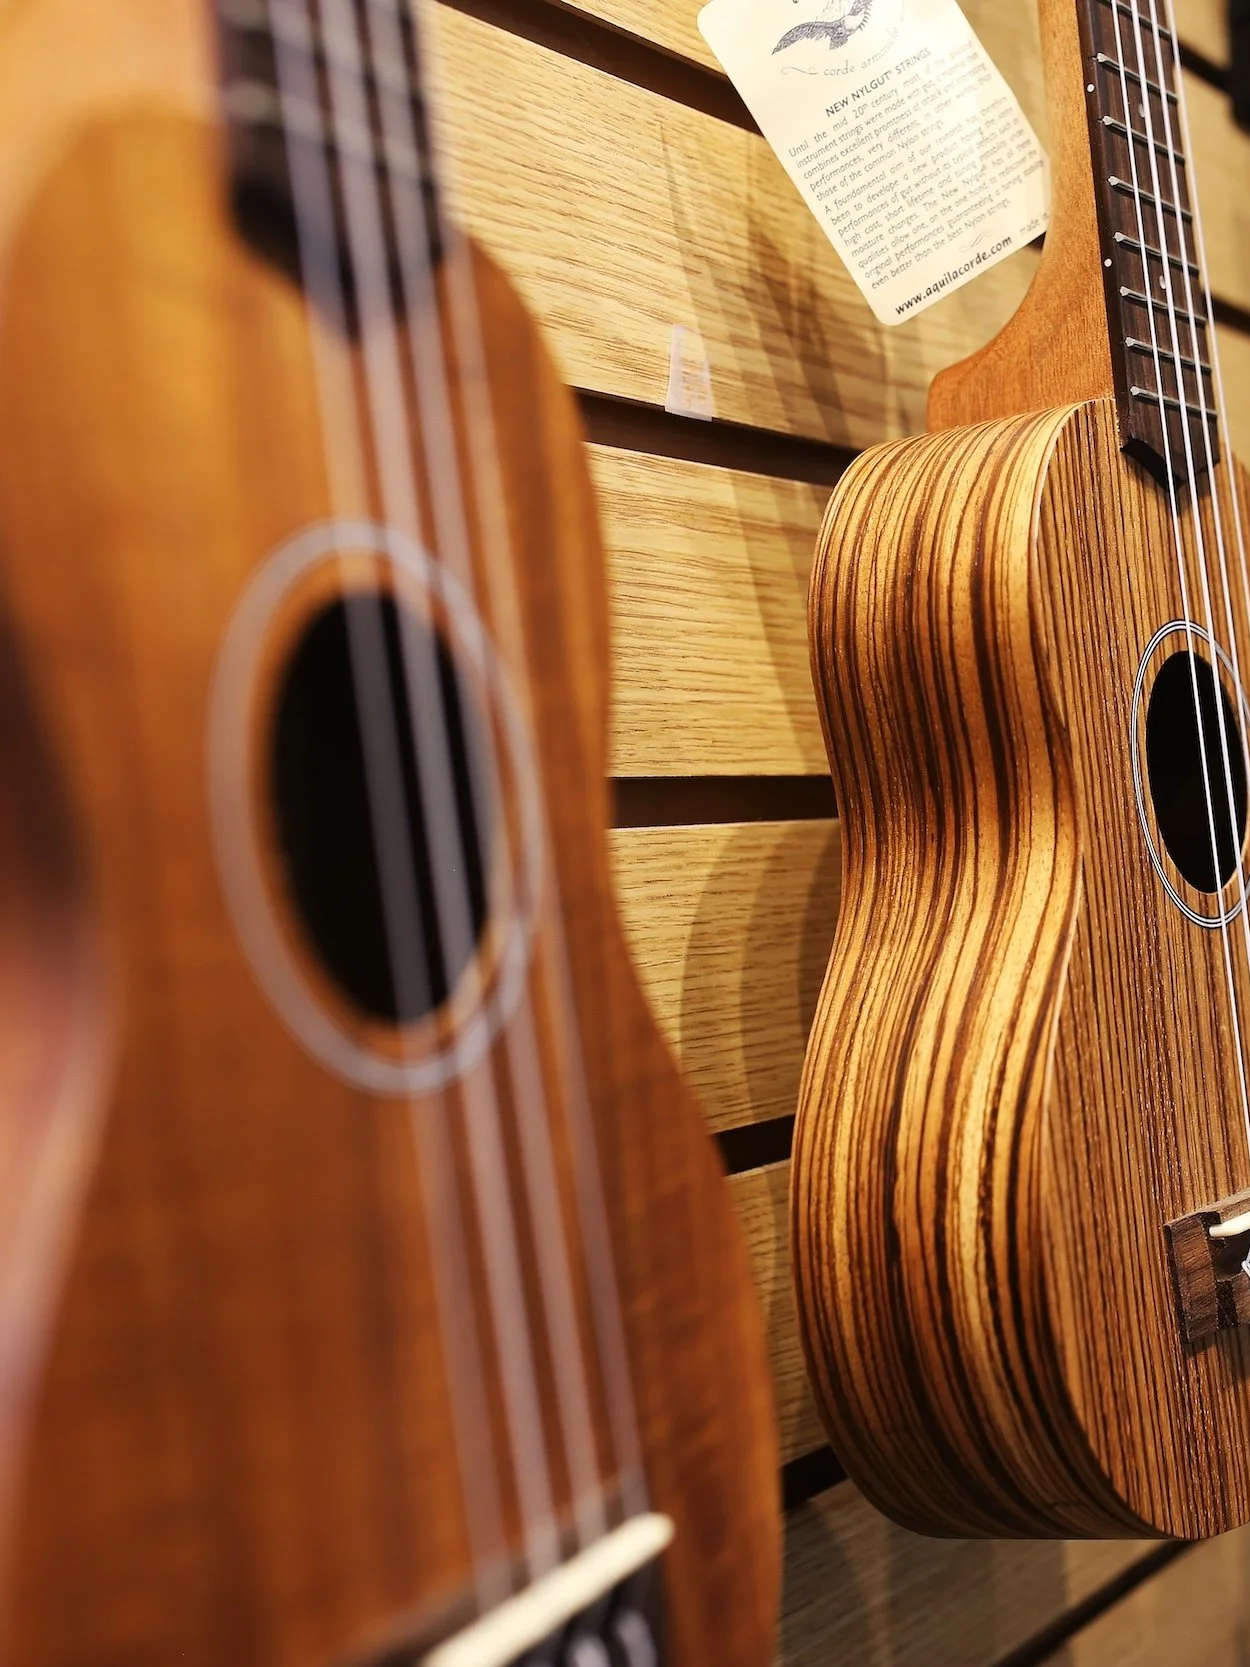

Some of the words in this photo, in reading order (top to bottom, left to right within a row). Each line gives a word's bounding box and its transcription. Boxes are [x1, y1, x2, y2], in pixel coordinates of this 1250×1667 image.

[823, 59, 855, 76] corde
[825, 97, 848, 117] NEW
[895, 47, 931, 75] STRINGS
[788, 140, 809, 157] Until
[813, 131, 827, 143] the
[832, 116, 848, 131] mid
[871, 88, 898, 108] century
[797, 139, 838, 168] instrument
[838, 124, 863, 143] strings
[865, 112, 883, 126] were
[884, 98, 906, 114] made
[907, 88, 919, 100] with
[803, 154, 839, 179] combines
[840, 132, 874, 157] excellent
[810, 155, 864, 192] performances,
[867, 143, 883, 154] very
[887, 119, 921, 143] different,
[816, 185, 838, 201] those
[849, 170, 862, 181] the
[864, 149, 896, 172] common
[897, 134, 919, 151] Nylon
[830, 210, 851, 225] been
[867, 180, 899, 203] develope
[912, 163, 927, 175] new
[834, 170, 887, 210] foundamental
[890, 161, 904, 174] aim
[919, 144, 931, 156] our
[838, 201, 889, 238] performances
[900, 185, 913, 199] gut
[913, 167, 941, 188] without
[943, 162, 952, 171] its
[844, 232, 861, 246] high
[864, 221, 883, 234] cost,
[885, 205, 905, 222] short
[906, 187, 934, 207] lifetime
[938, 174, 952, 189] and
[851, 234, 884, 257] moisture
[922, 200, 938, 211] The
[941, 188, 958, 200] New
[858, 245, 889, 269] qualities
[891, 234, 910, 248] allow
[912, 222, 929, 234] one,
[940, 205, 953, 216] the
[955, 195, 968, 207] one
[865, 256, 892, 278] original
[895, 225, 945, 262] performances
[872, 275, 889, 289] even
[890, 259, 912, 278] better
[914, 248, 932, 262] than
[933, 239, 946, 250] the
[947, 227, 963, 241] best
[964, 213, 986, 227] Nylon
[895, 236, 1012, 315] www.aquilacorde.com
